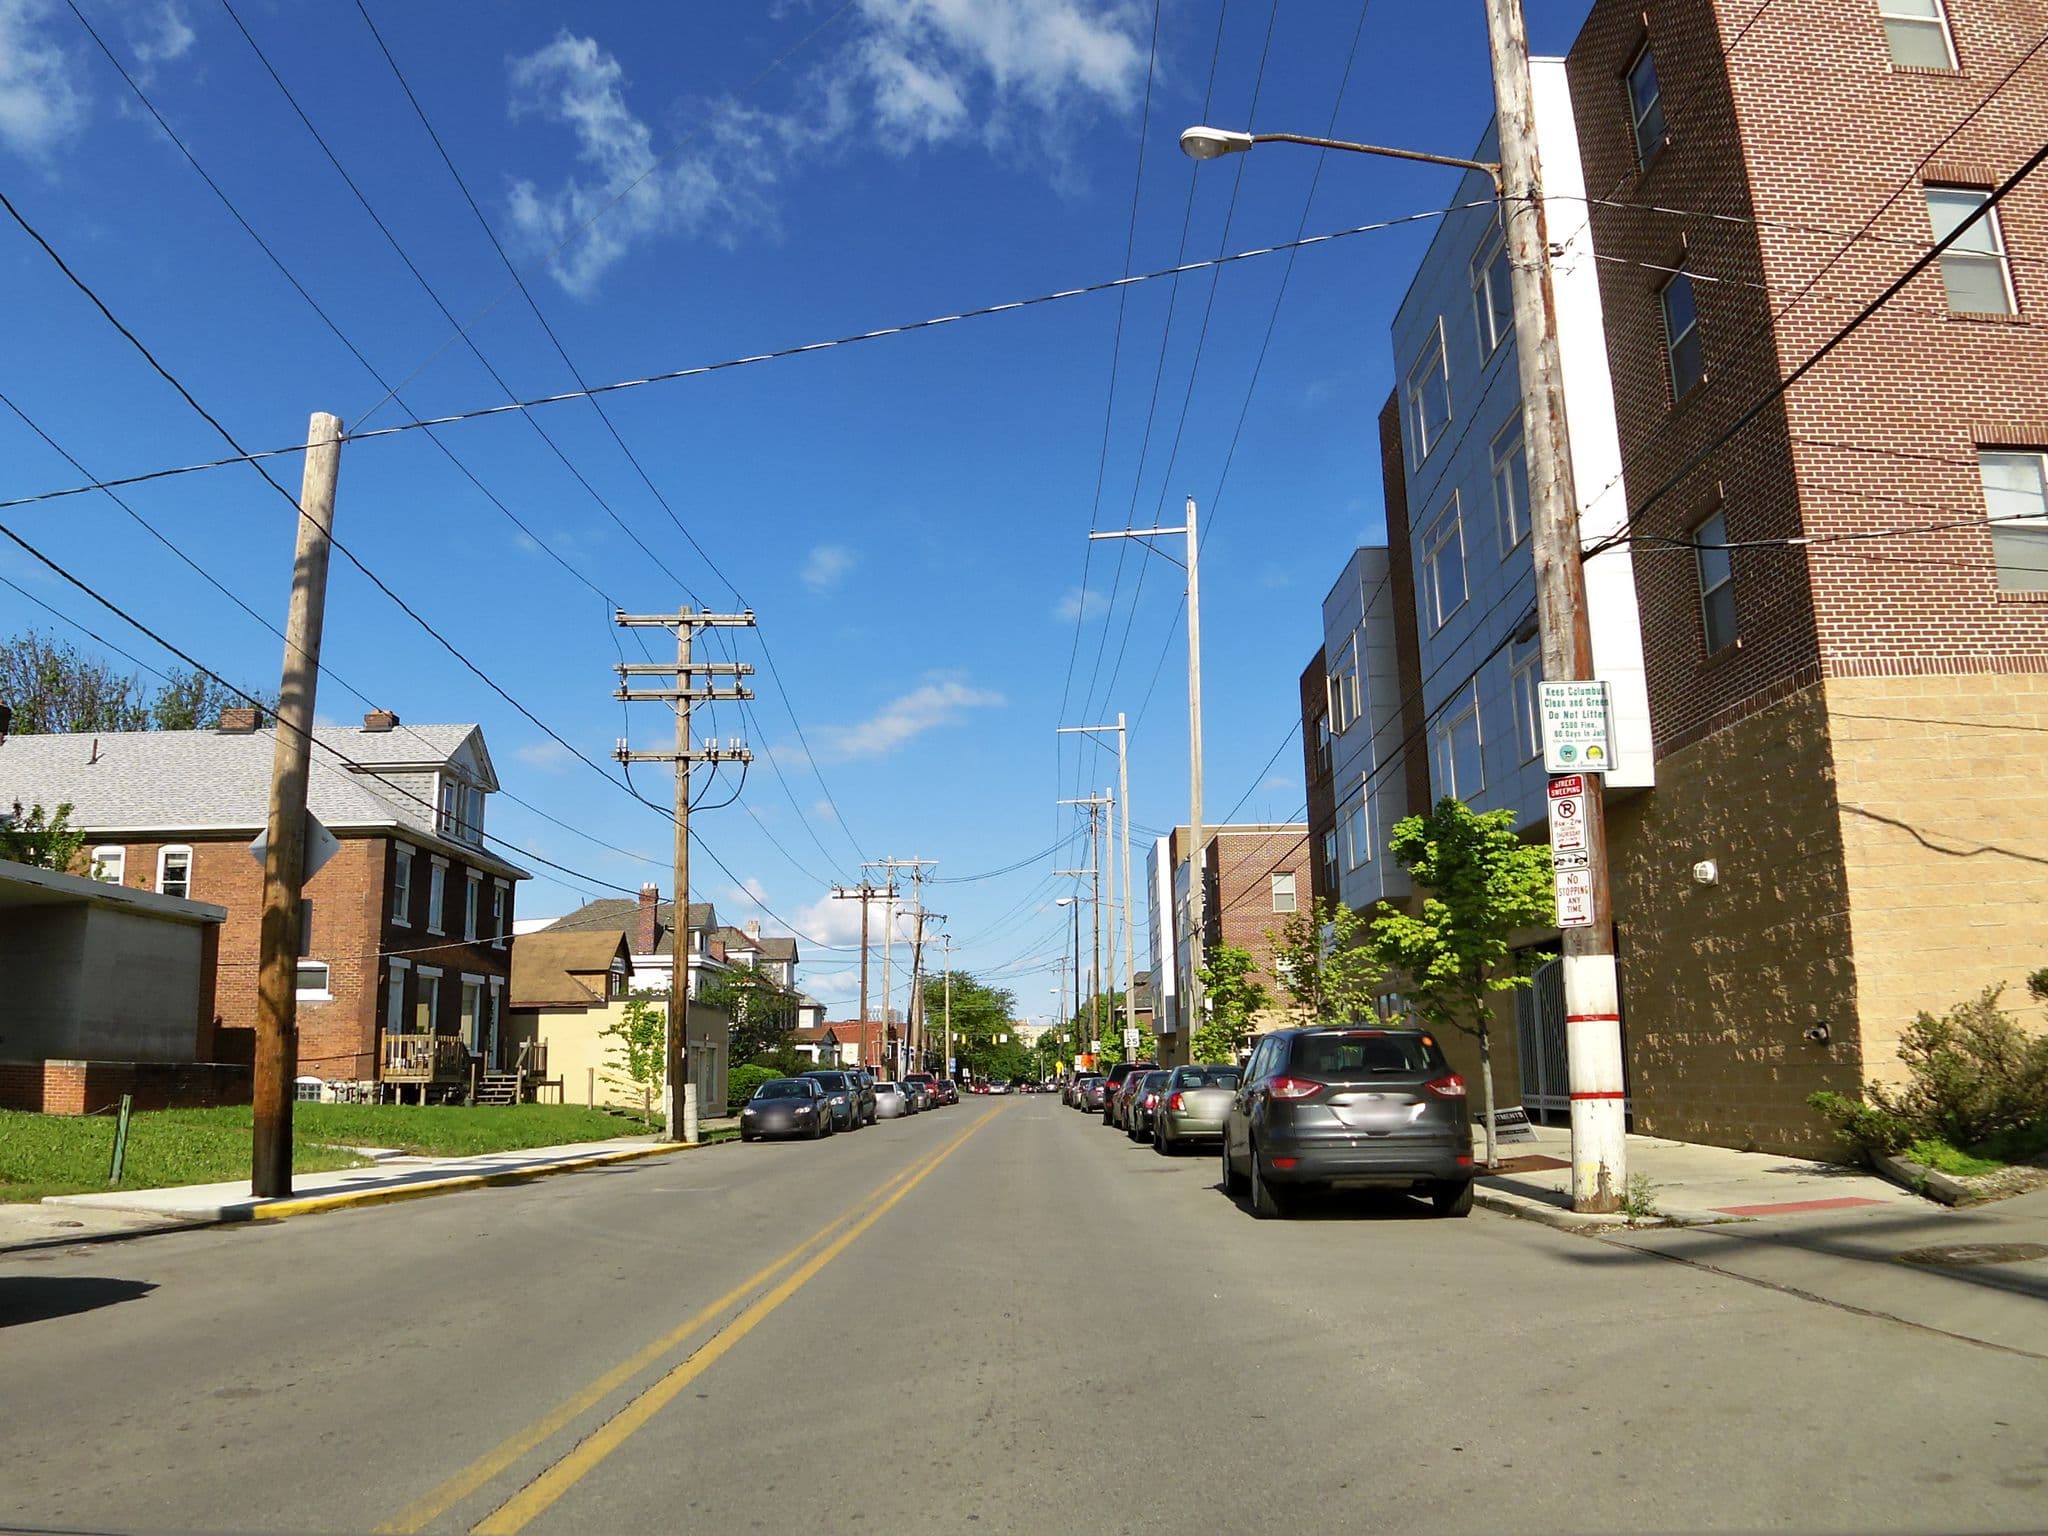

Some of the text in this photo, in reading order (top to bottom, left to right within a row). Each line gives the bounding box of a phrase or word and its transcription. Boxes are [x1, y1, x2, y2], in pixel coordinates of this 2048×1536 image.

[1546, 687, 1564, 697] Keep
[1544, 698, 1566, 708] Clean
[1569, 697, 1584, 707] and
[1548, 710, 1560, 720] Do
[1563, 710, 1578, 719] Not
[1554, 778, 1576, 789] STREET
[1551, 786, 1580, 797] SWEEPING
[1567, 876, 1578, 884] NO
[1558, 886, 1589, 896] STOPPING
[1126, 1038, 1138, 1046] 25
